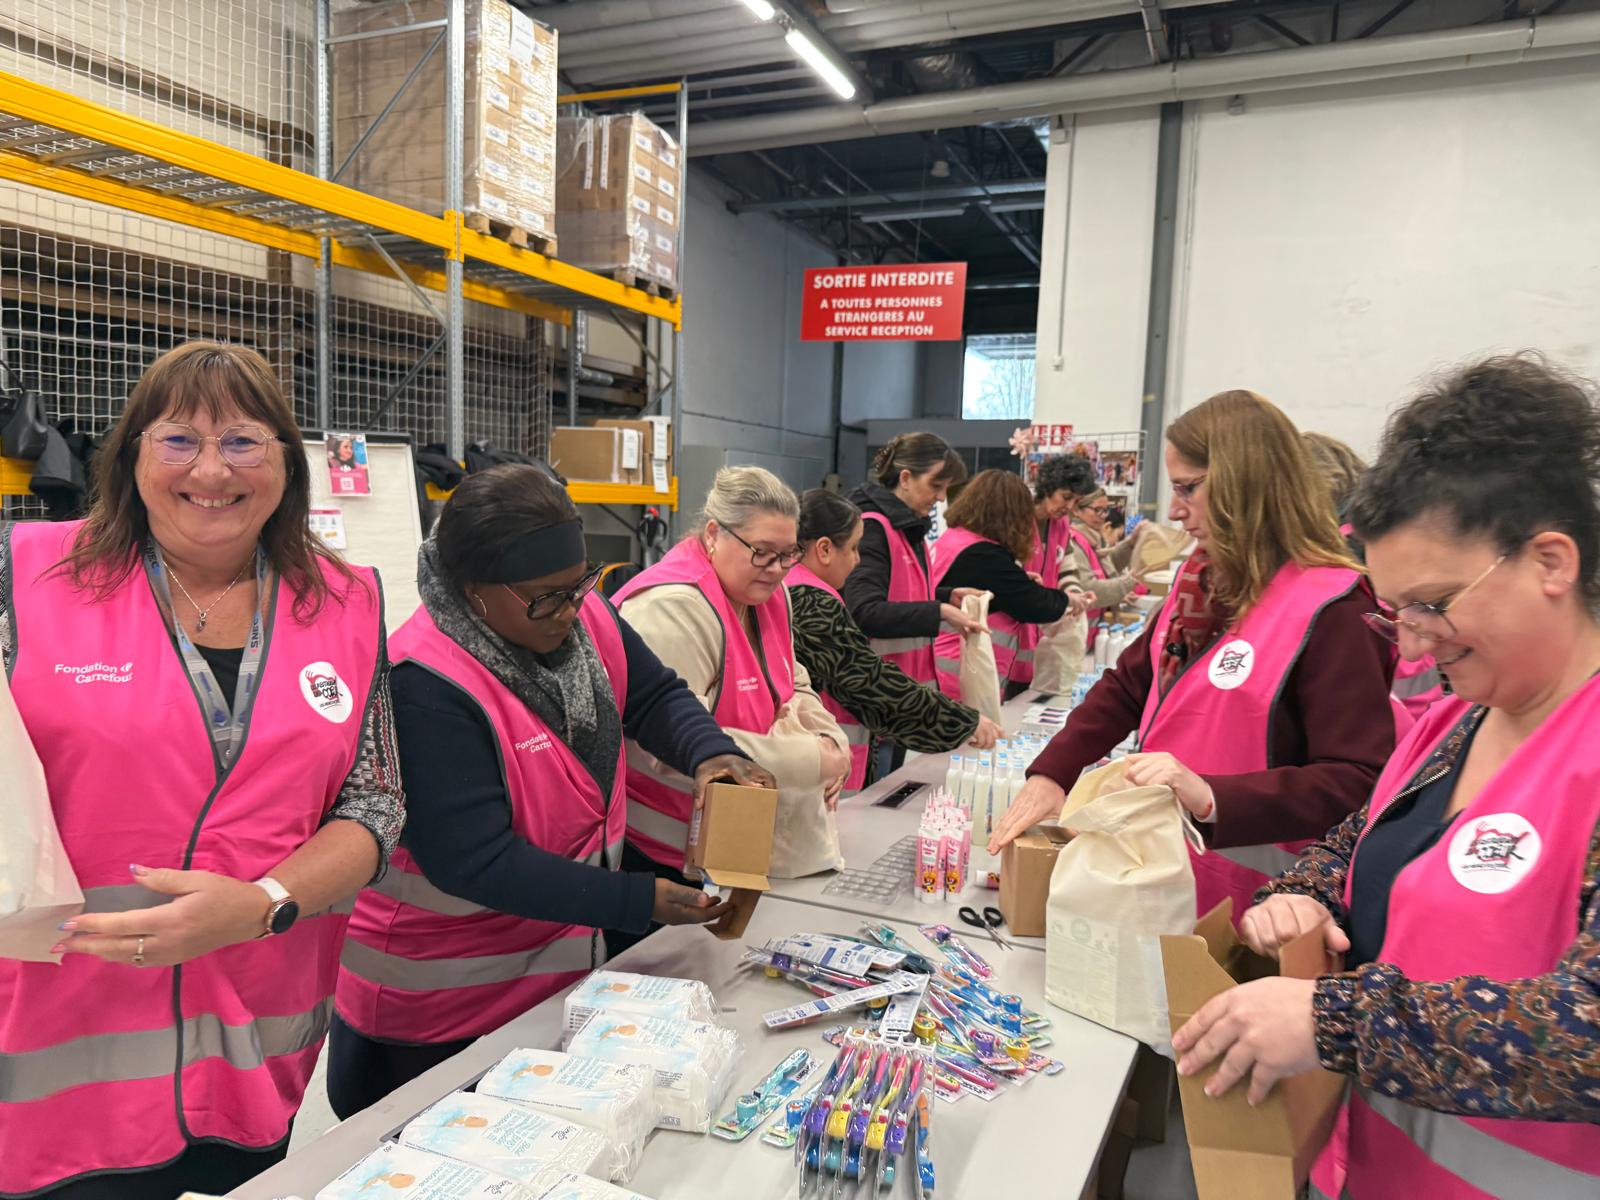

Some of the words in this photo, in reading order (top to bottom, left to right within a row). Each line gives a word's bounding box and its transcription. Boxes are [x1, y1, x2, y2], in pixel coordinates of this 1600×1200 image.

[813, 274, 867, 289] SORTIE
[871, 271, 954, 287] INTERDITE
[820, 299, 829, 309] A
[832, 298, 872, 309] TOUTES
[875, 296, 943, 308] PERSONNES
[834, 311, 904, 323] ETRANGERES
[907, 311, 925, 322] AU
[825, 326, 869, 337] SERVICE
[871, 325, 934, 336] RECEPTION
[54, 661, 118, 674] Fondation
[75, 672, 133, 684] Carrefour
